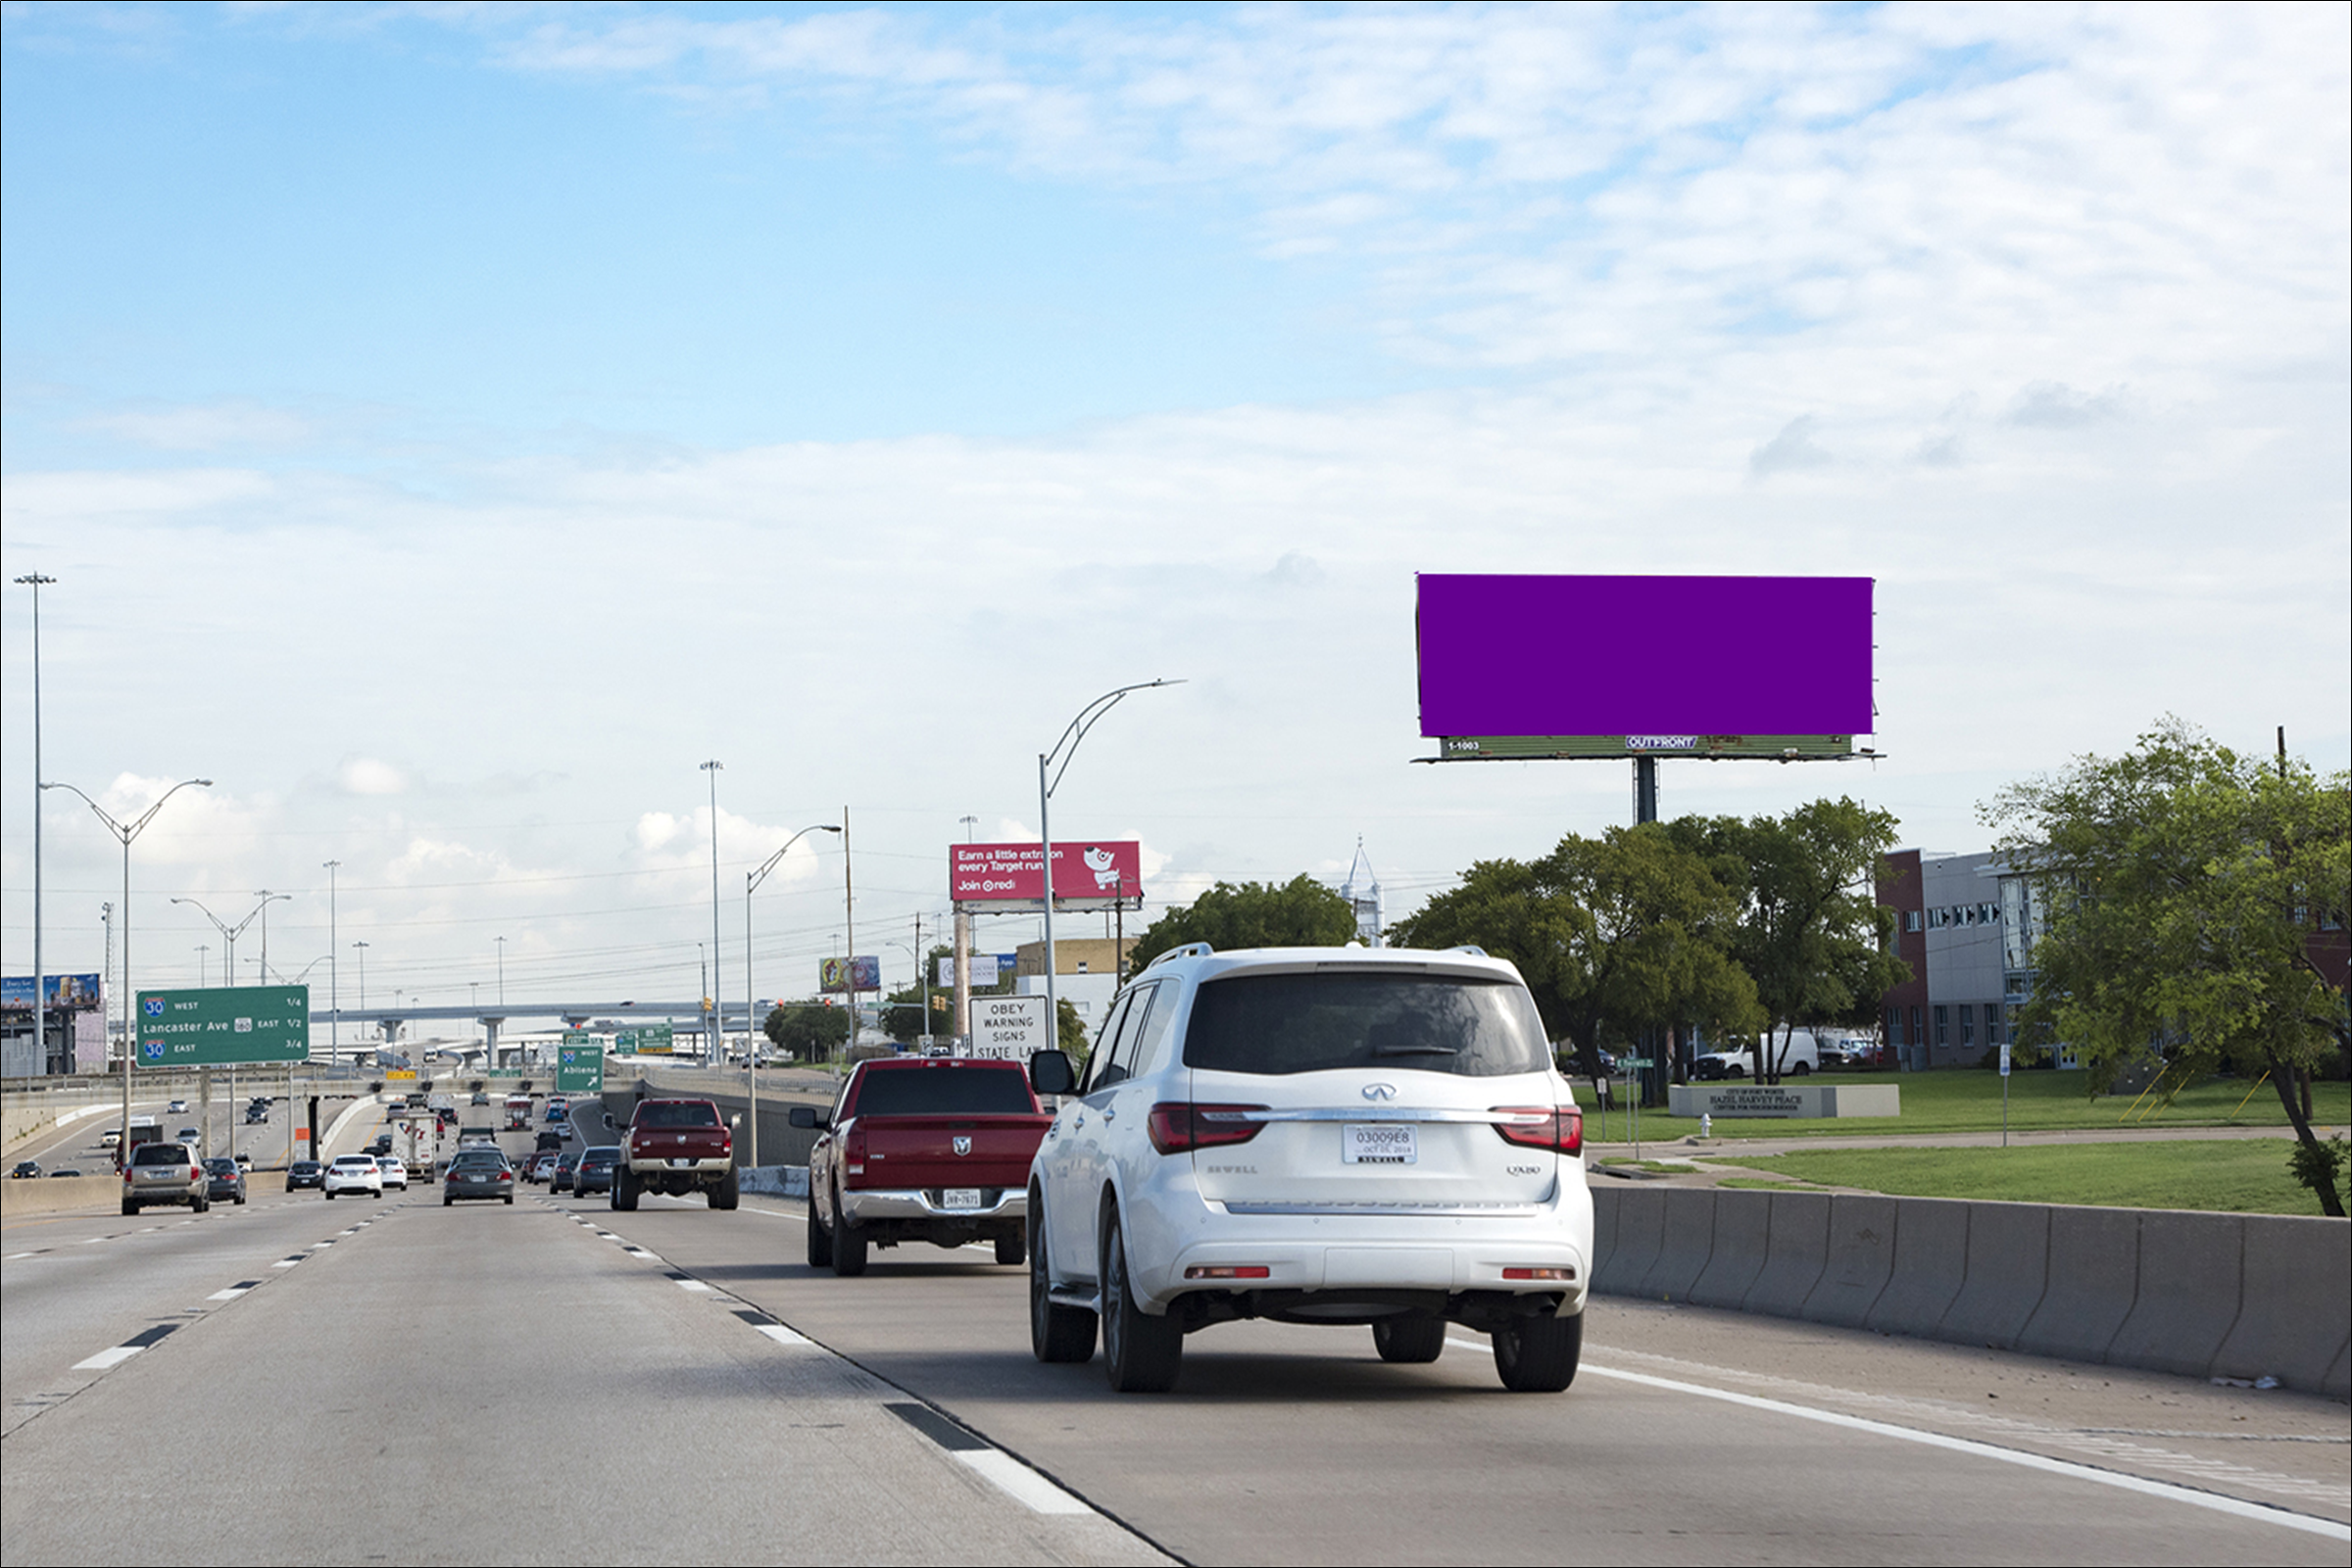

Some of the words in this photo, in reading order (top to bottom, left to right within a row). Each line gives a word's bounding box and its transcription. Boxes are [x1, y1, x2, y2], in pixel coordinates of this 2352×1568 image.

[1629, 736, 1695, 748] OUTFRONT
[958, 851, 983, 860] Earn
[995, 850, 1017, 859] little
[958, 863, 988, 873] every
[990, 861, 1023, 872] Target
[958, 880, 980, 891] Join
[146, 1004, 164, 1013] 30
[286, 998, 301, 1006] 1/4
[990, 1004, 1025, 1015] OBEY
[144, 1022, 202, 1034] Lancaster
[207, 1022, 228, 1031] Ave
[286, 1019, 301, 1028] 1/2
[983, 1017, 1034, 1028] WARNING
[993, 1031, 1026, 1042] SIGNS
[146, 1046, 164, 1055] 30
[285, 1039, 302, 1049] 3/4
[978, 1047, 1010, 1058] STATE
[564, 1066, 597, 1075] Abilene
[1710, 1096, 1737, 1104] HAZEL
[1739, 1096, 1772, 1104] HARVEY
[1775, 1096, 1802, 1104] PEACE
[1356, 1132, 1410, 1143] 03009E8
